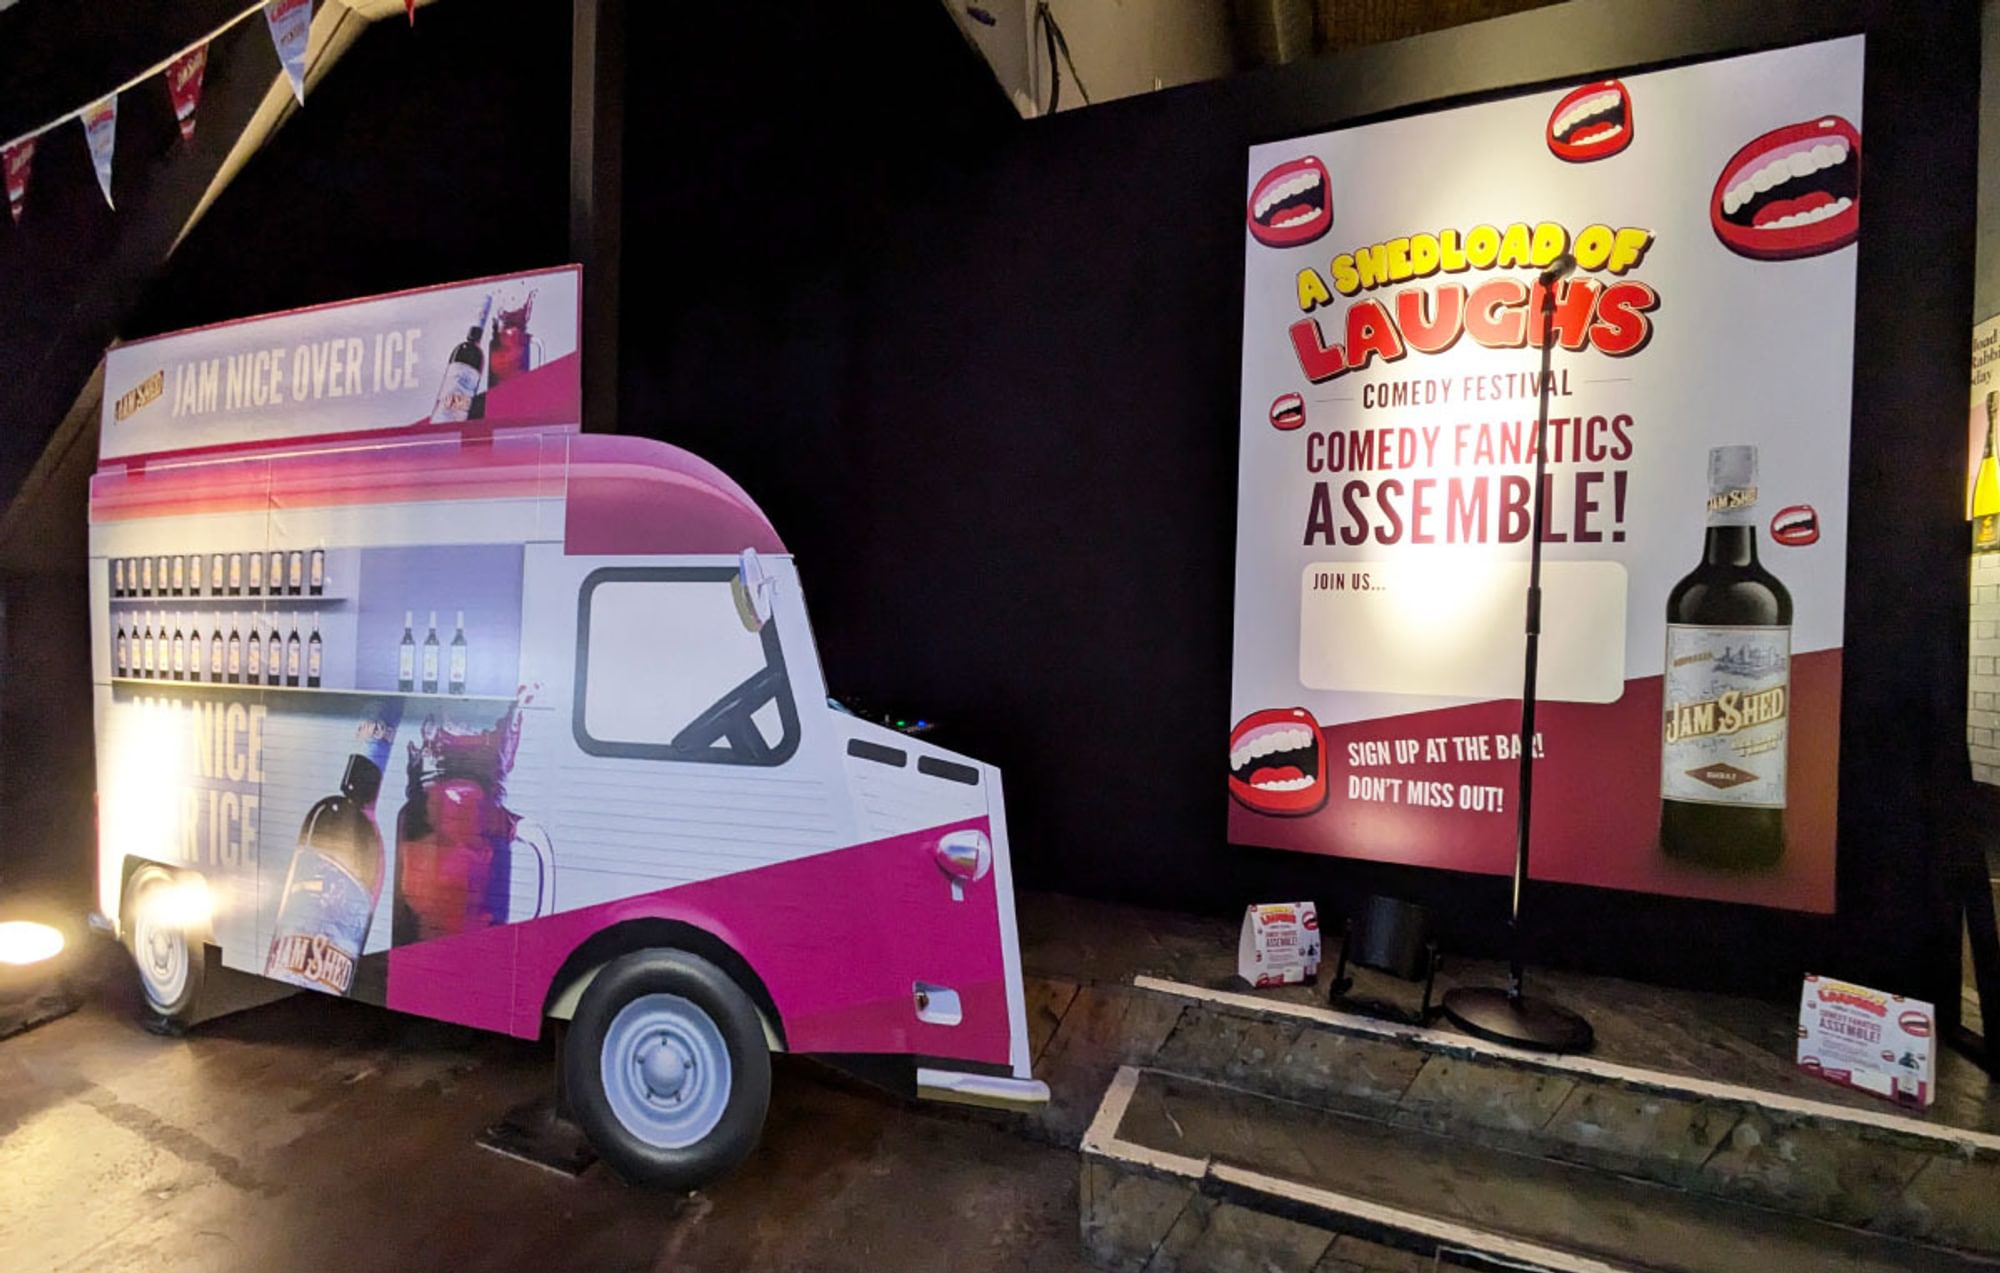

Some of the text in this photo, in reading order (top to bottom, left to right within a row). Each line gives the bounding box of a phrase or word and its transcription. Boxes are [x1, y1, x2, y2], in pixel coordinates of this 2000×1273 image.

[1296, 221, 1656, 313] A SHEDLOAD OF
[1288, 275, 1660, 384] LAUGHS
[172, 328, 422, 418] JAM NICE OVER ICE
[1363, 369, 1573, 409] COMEDY FESTIVAL
[1306, 413, 1635, 473] COMEDY FANATICS
[1303, 470, 1628, 546] ASSEMBLE!
[1313, 573, 1386, 590] JOIN US...
[192, 700, 267, 784] NICE
[1666, 687, 1785, 743] JAM SHED
[1347, 740, 1391, 767] SIGN
[1395, 739, 1420, 764] UP
[1425, 738, 1448, 763] AT
[1452, 735, 1491, 762] THE
[1348, 775, 1504, 813] DON'T MISS OUT!
[210, 789, 262, 868] ICE
[303, 934, 353, 992] SHED
